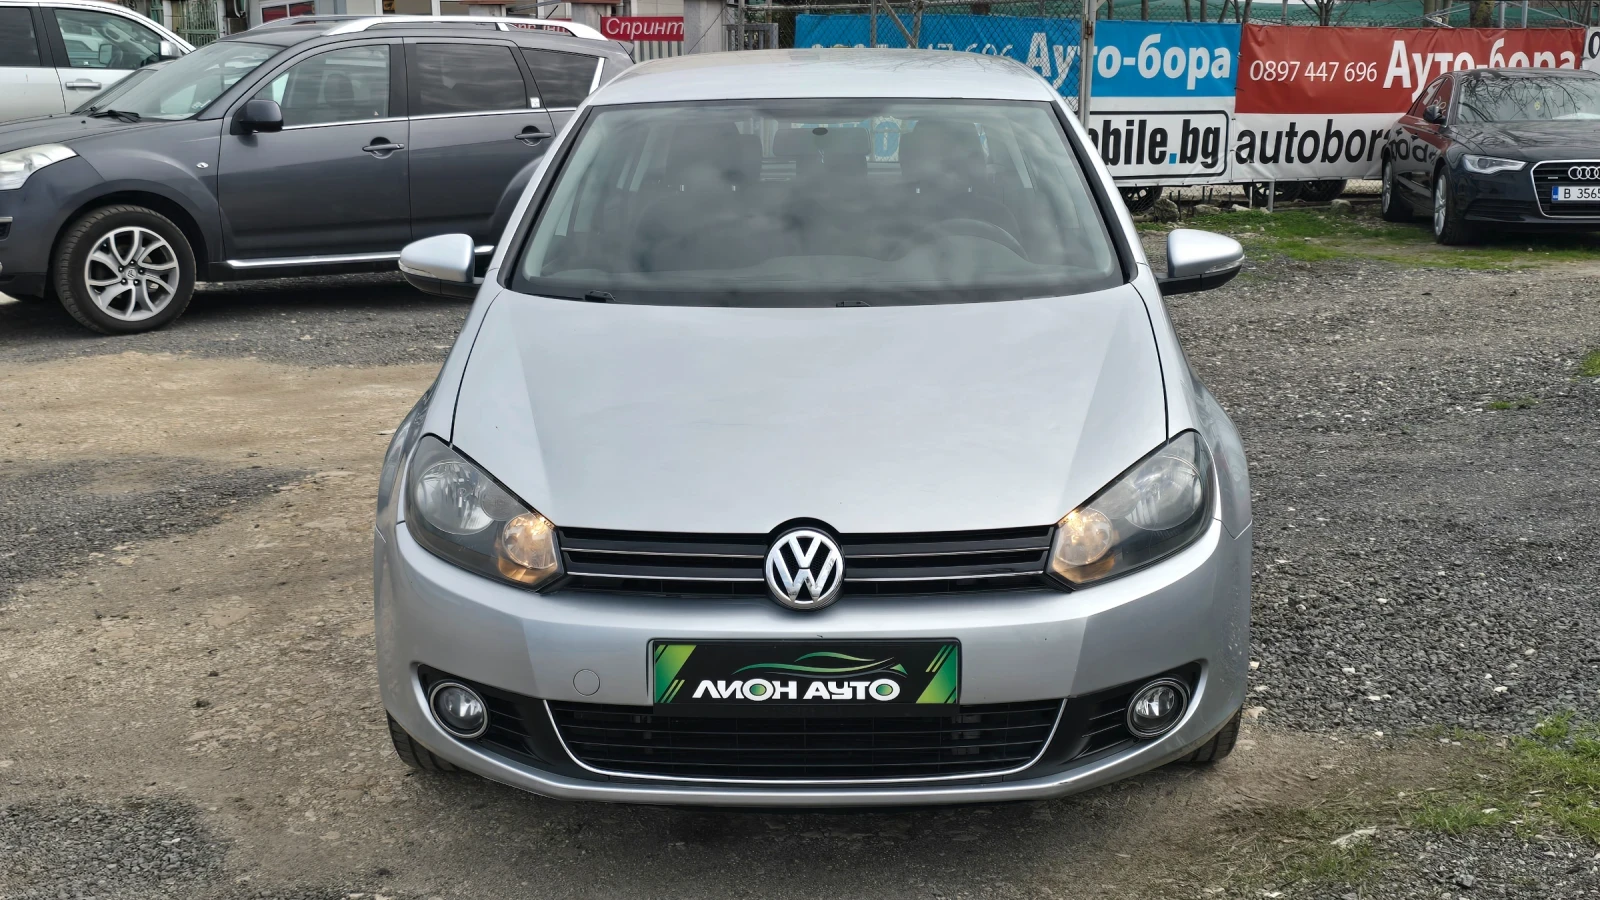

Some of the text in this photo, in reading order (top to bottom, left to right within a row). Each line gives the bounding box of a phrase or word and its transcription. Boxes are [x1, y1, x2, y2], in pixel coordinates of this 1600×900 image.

[606, 18, 684, 40] Спринт
[1026, 32, 1231, 91] Ауо-бора
[1250, 60, 1300, 82] 0897
[1304, 61, 1339, 82] 447
[1344, 61, 1377, 83] 696
[692, 678, 901, 701] ЛИОН АУТО
